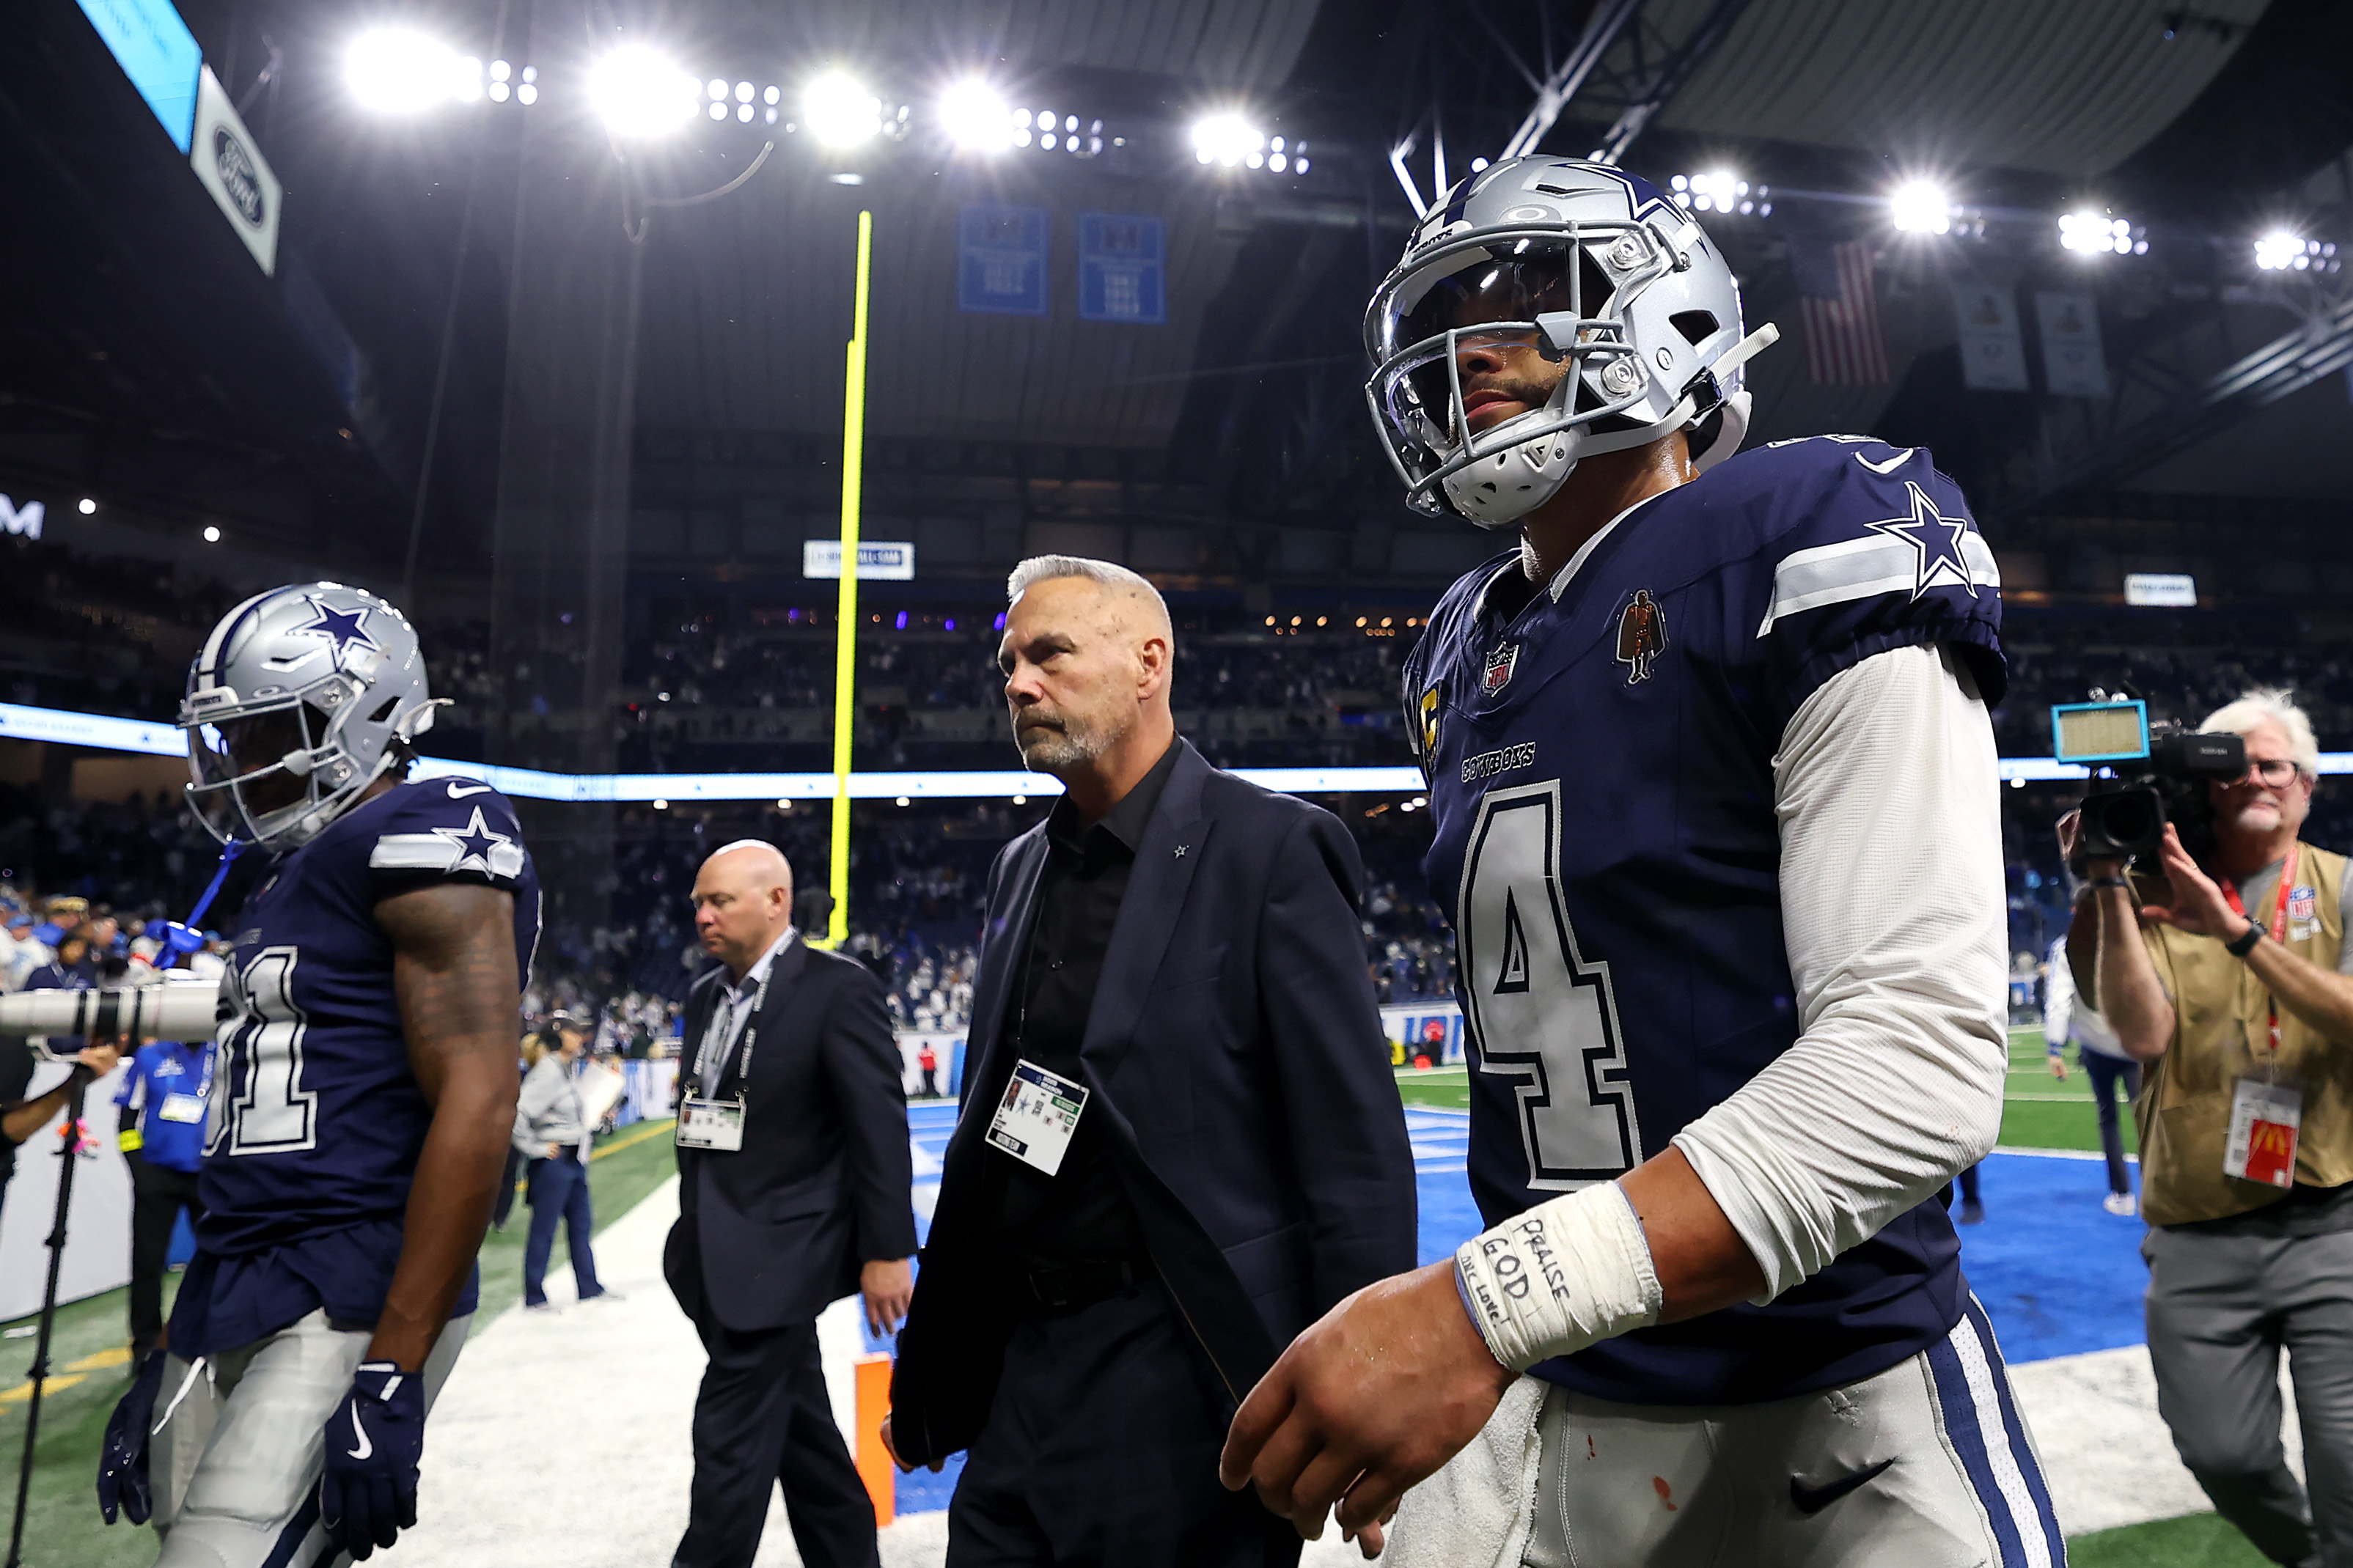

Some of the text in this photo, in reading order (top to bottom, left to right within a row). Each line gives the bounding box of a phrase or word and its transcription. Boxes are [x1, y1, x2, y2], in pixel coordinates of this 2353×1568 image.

[1461, 741, 1535, 783] COWBOYS
[1457, 779, 1642, 1191] 4
[1483, 1237, 1529, 1300] GOD
[1513, 1219, 1570, 1300] PRAISE
